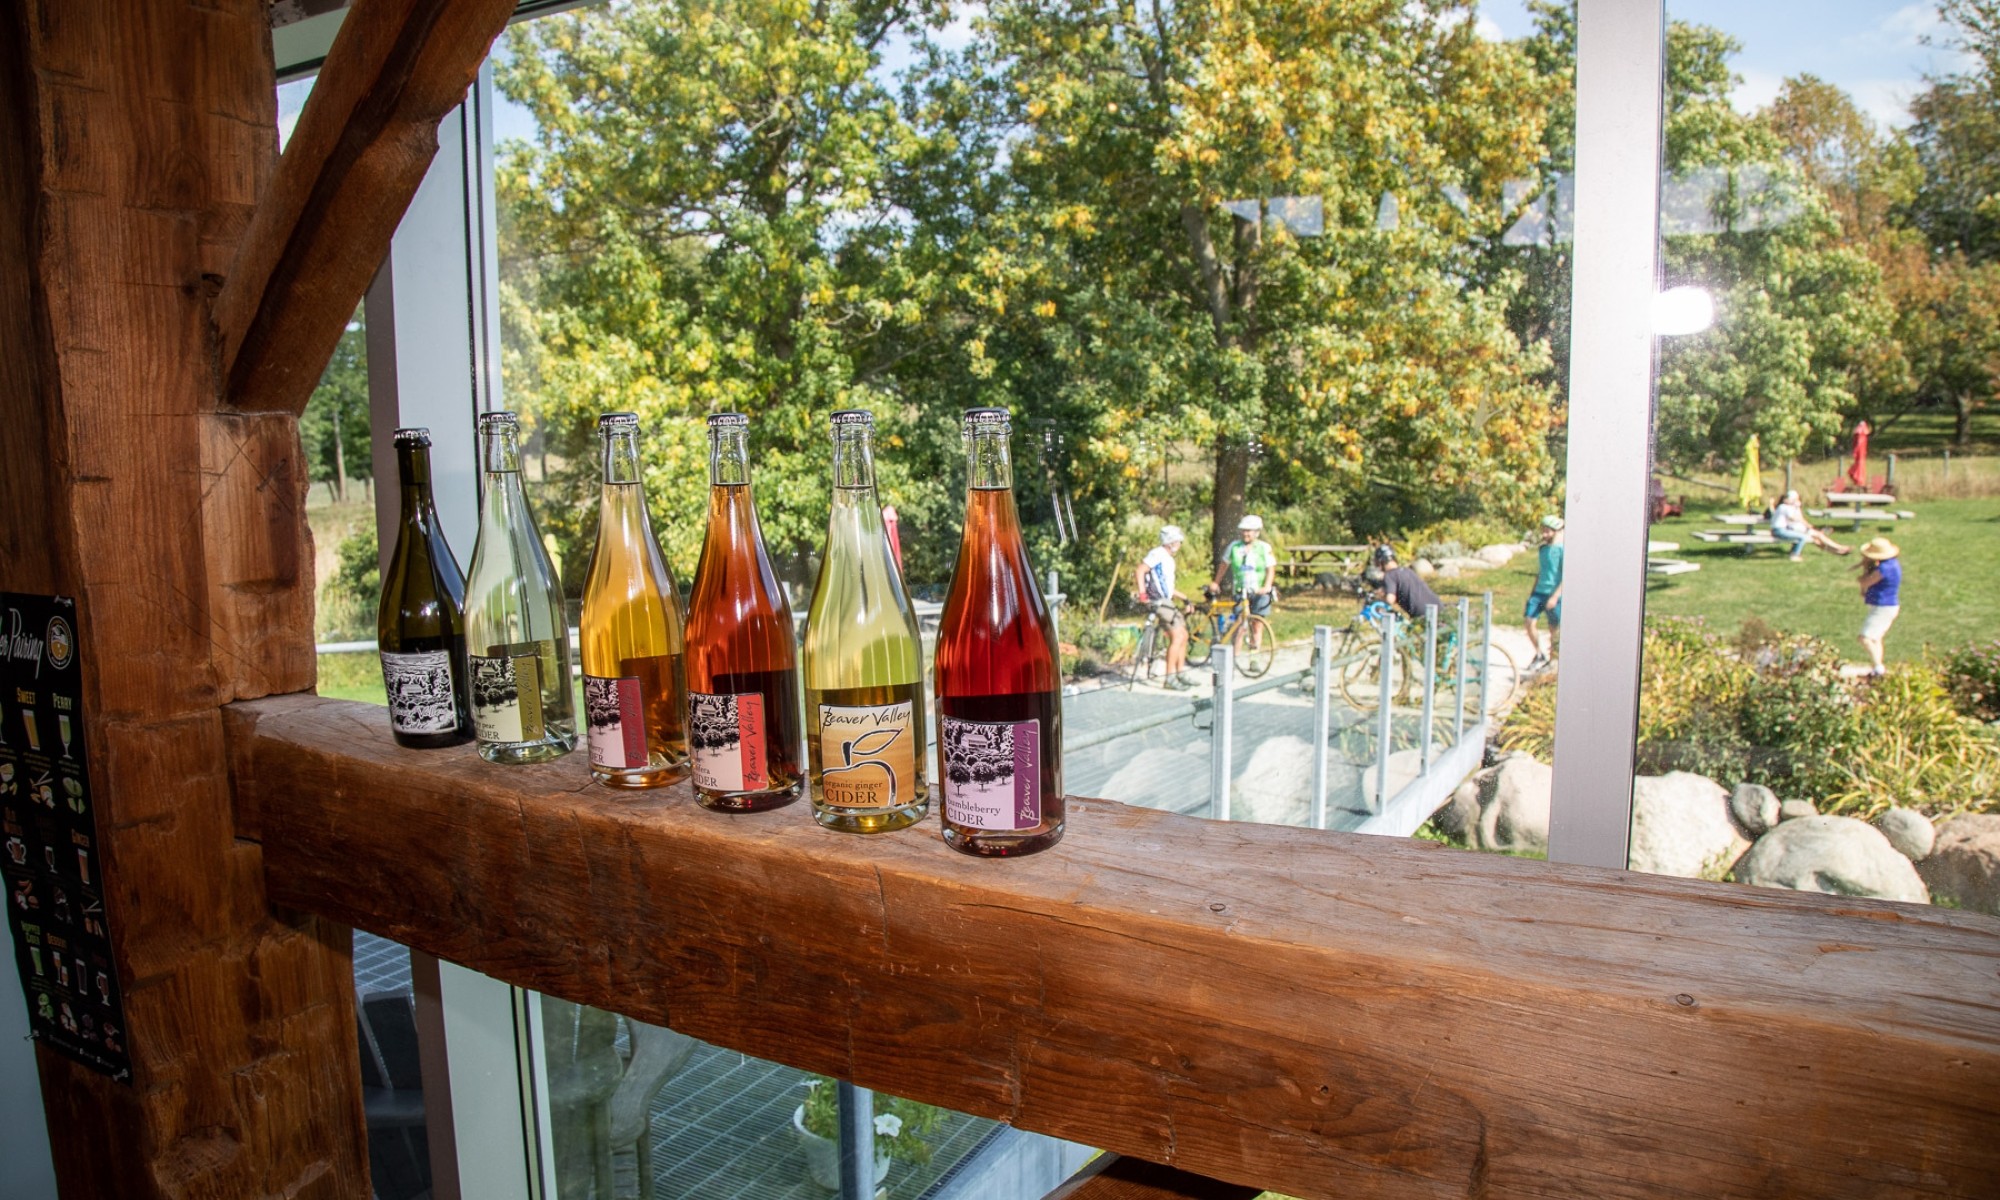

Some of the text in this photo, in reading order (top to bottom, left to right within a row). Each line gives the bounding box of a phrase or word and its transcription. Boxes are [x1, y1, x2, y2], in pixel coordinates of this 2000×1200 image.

[7, 607, 44, 679] Pairing
[821, 706, 911, 733] Beaver Valley
[741, 700, 760, 782] Beaver Valley
[825, 780, 883, 791] organic ginger
[1016, 728, 1038, 821] Beaver Valley
[825, 789, 878, 804] CIDER
[947, 807, 984, 826] CIDER
